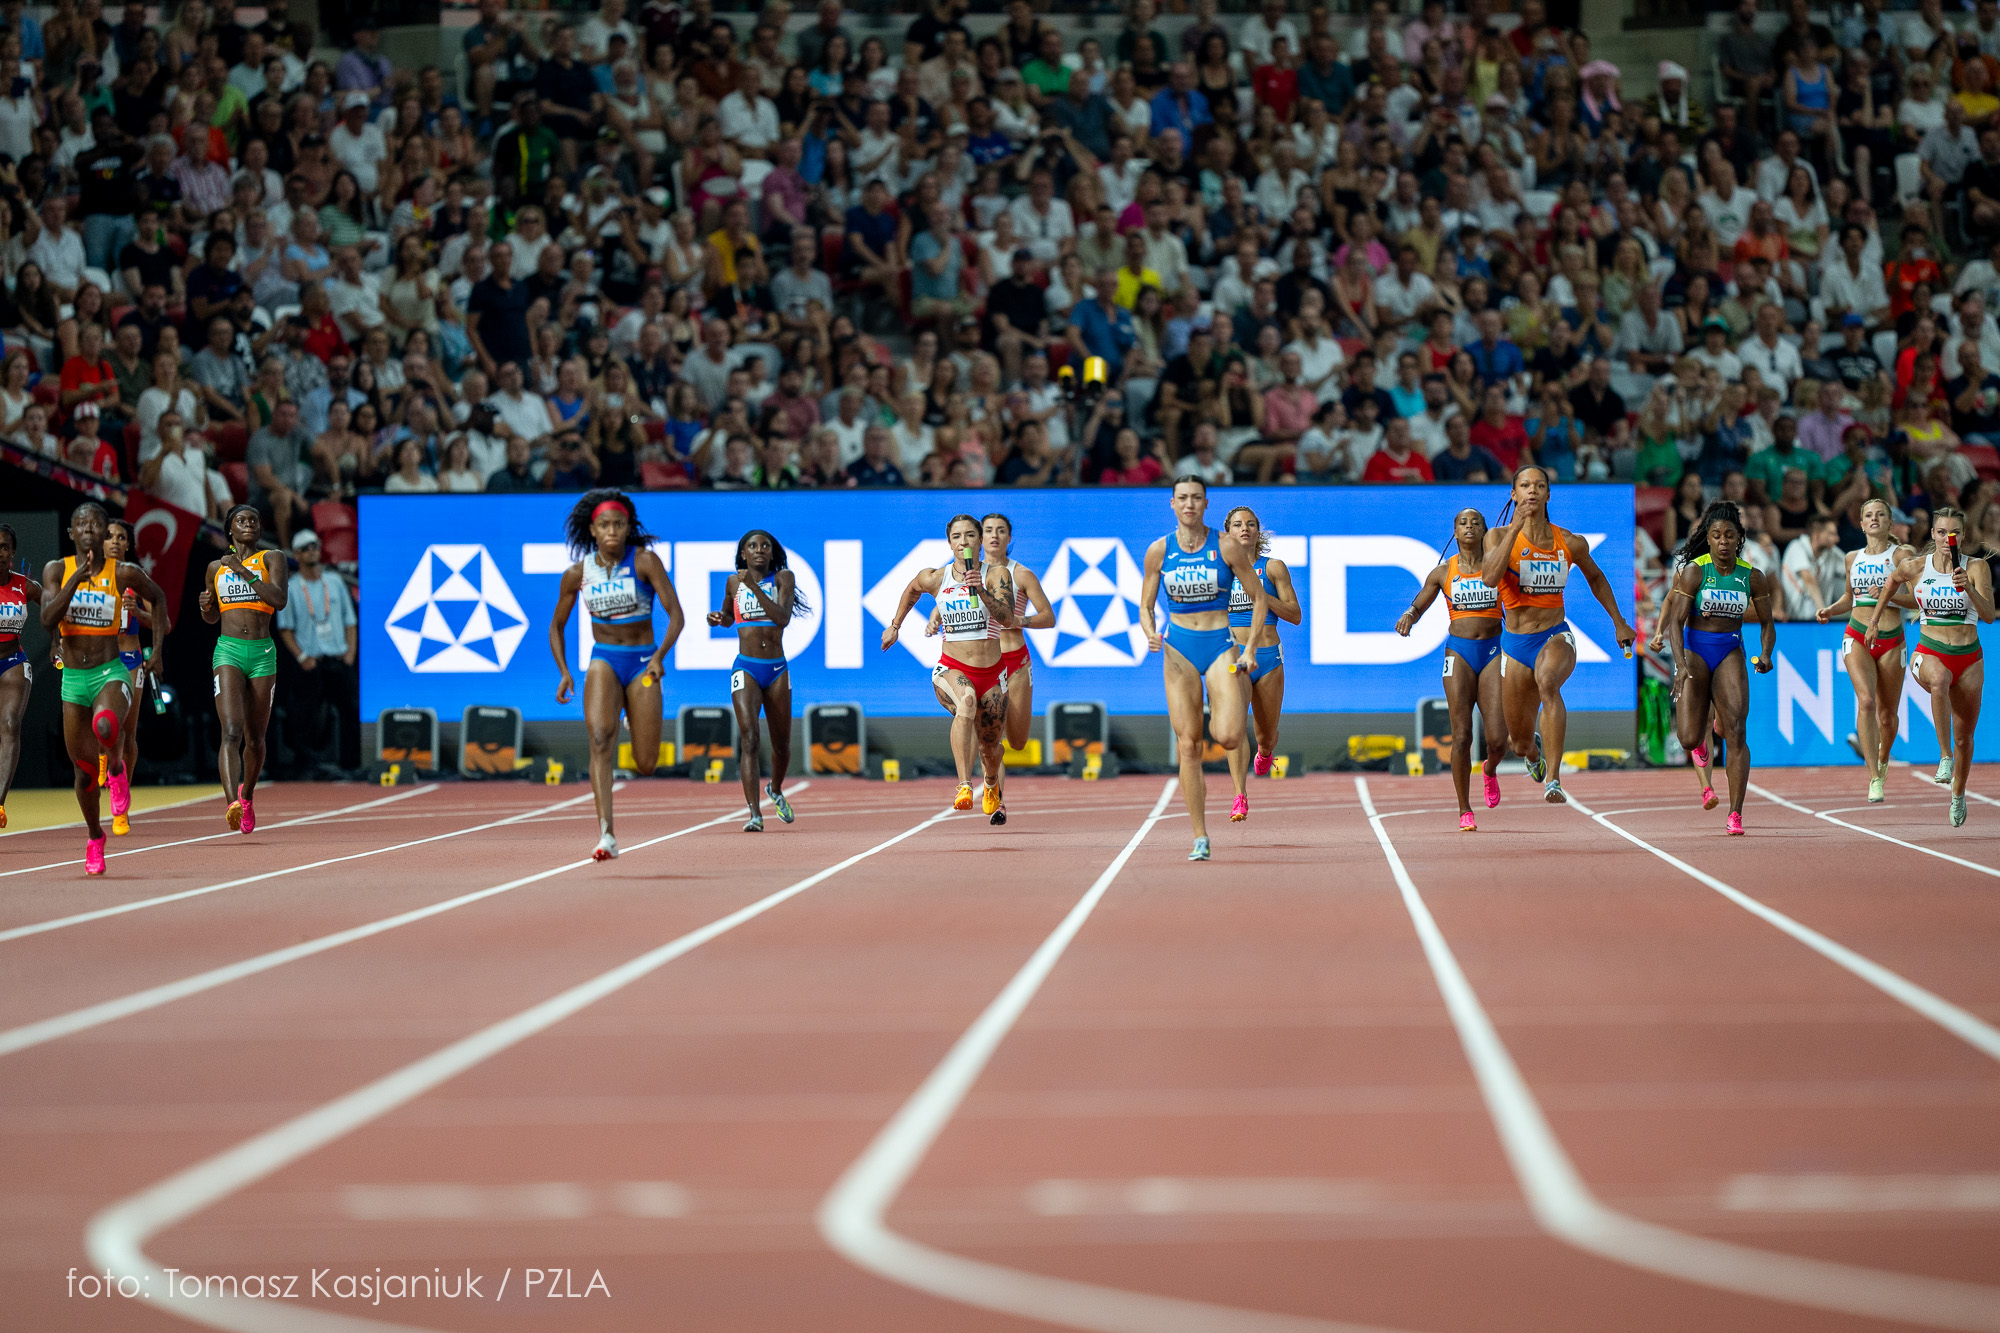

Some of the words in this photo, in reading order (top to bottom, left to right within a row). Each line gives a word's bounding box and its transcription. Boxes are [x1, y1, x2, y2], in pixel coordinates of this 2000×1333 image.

[1530, 561, 1561, 573] NTN
[1858, 564, 1884, 575] NTN
[1175, 570, 1208, 582] NTN
[1532, 574, 1556, 586] JIYA
[591, 580, 624, 596] NTN
[746, 587, 773, 600] NN
[1169, 583, 1214, 595] PAVESE
[1931, 586, 1961, 597] NTN
[71, 592, 105, 605] NTN
[588, 593, 634, 611] JEFFERSON
[1454, 590, 1496, 603] SAMUEL
[1711, 590, 1740, 602] NTN
[1703, 601, 1744, 613] SANTOS
[1926, 598, 1964, 609] KOCSIS
[71, 606, 103, 619] KONÉ
[943, 609, 985, 625] SWOBODA
[75, 618, 103, 626] BUDAPEST
[733, 675, 739, 689] 6
